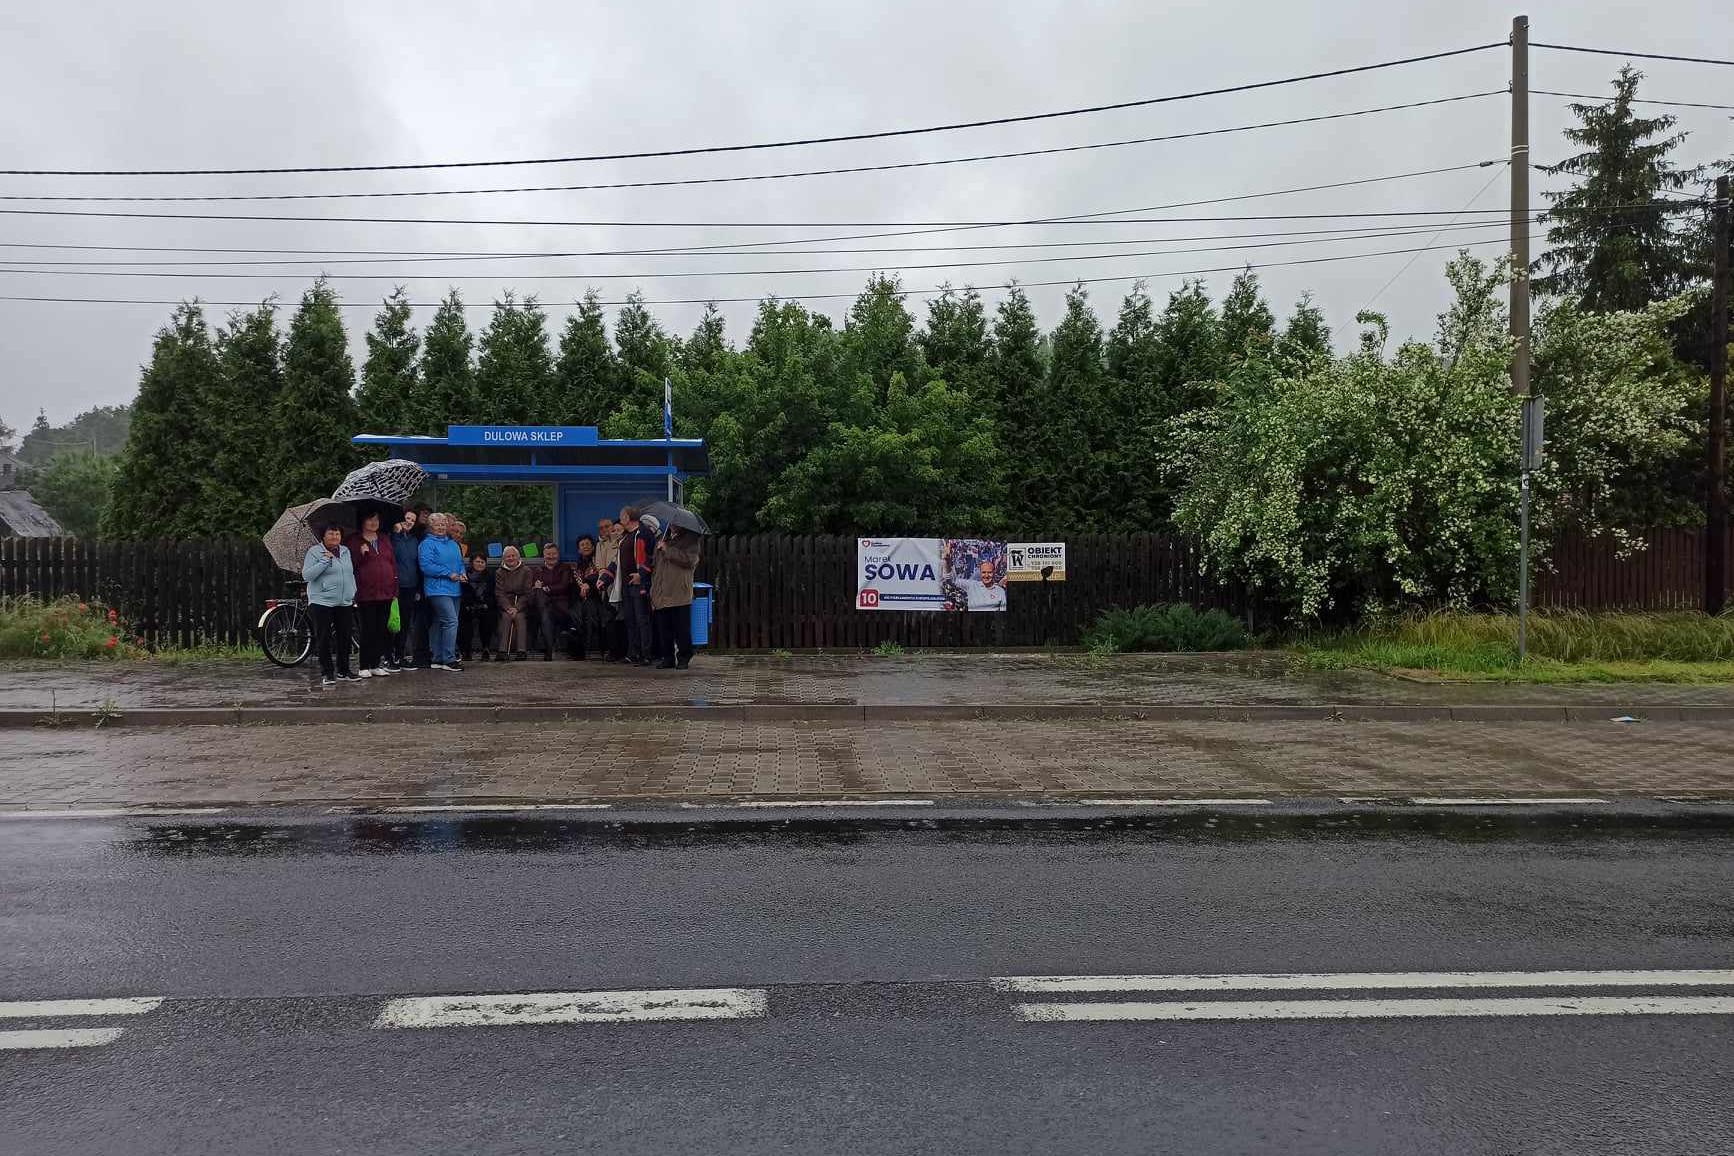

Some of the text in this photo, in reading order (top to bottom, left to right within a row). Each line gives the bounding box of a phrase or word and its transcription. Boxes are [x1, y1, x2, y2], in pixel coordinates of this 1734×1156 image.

[484, 431, 564, 442] DULOWA SKLEP
[1027, 546, 1063, 554] OBIEKT
[864, 555, 891, 563] Marek
[864, 563, 934, 581] SOWA
[861, 593, 877, 605] 10
